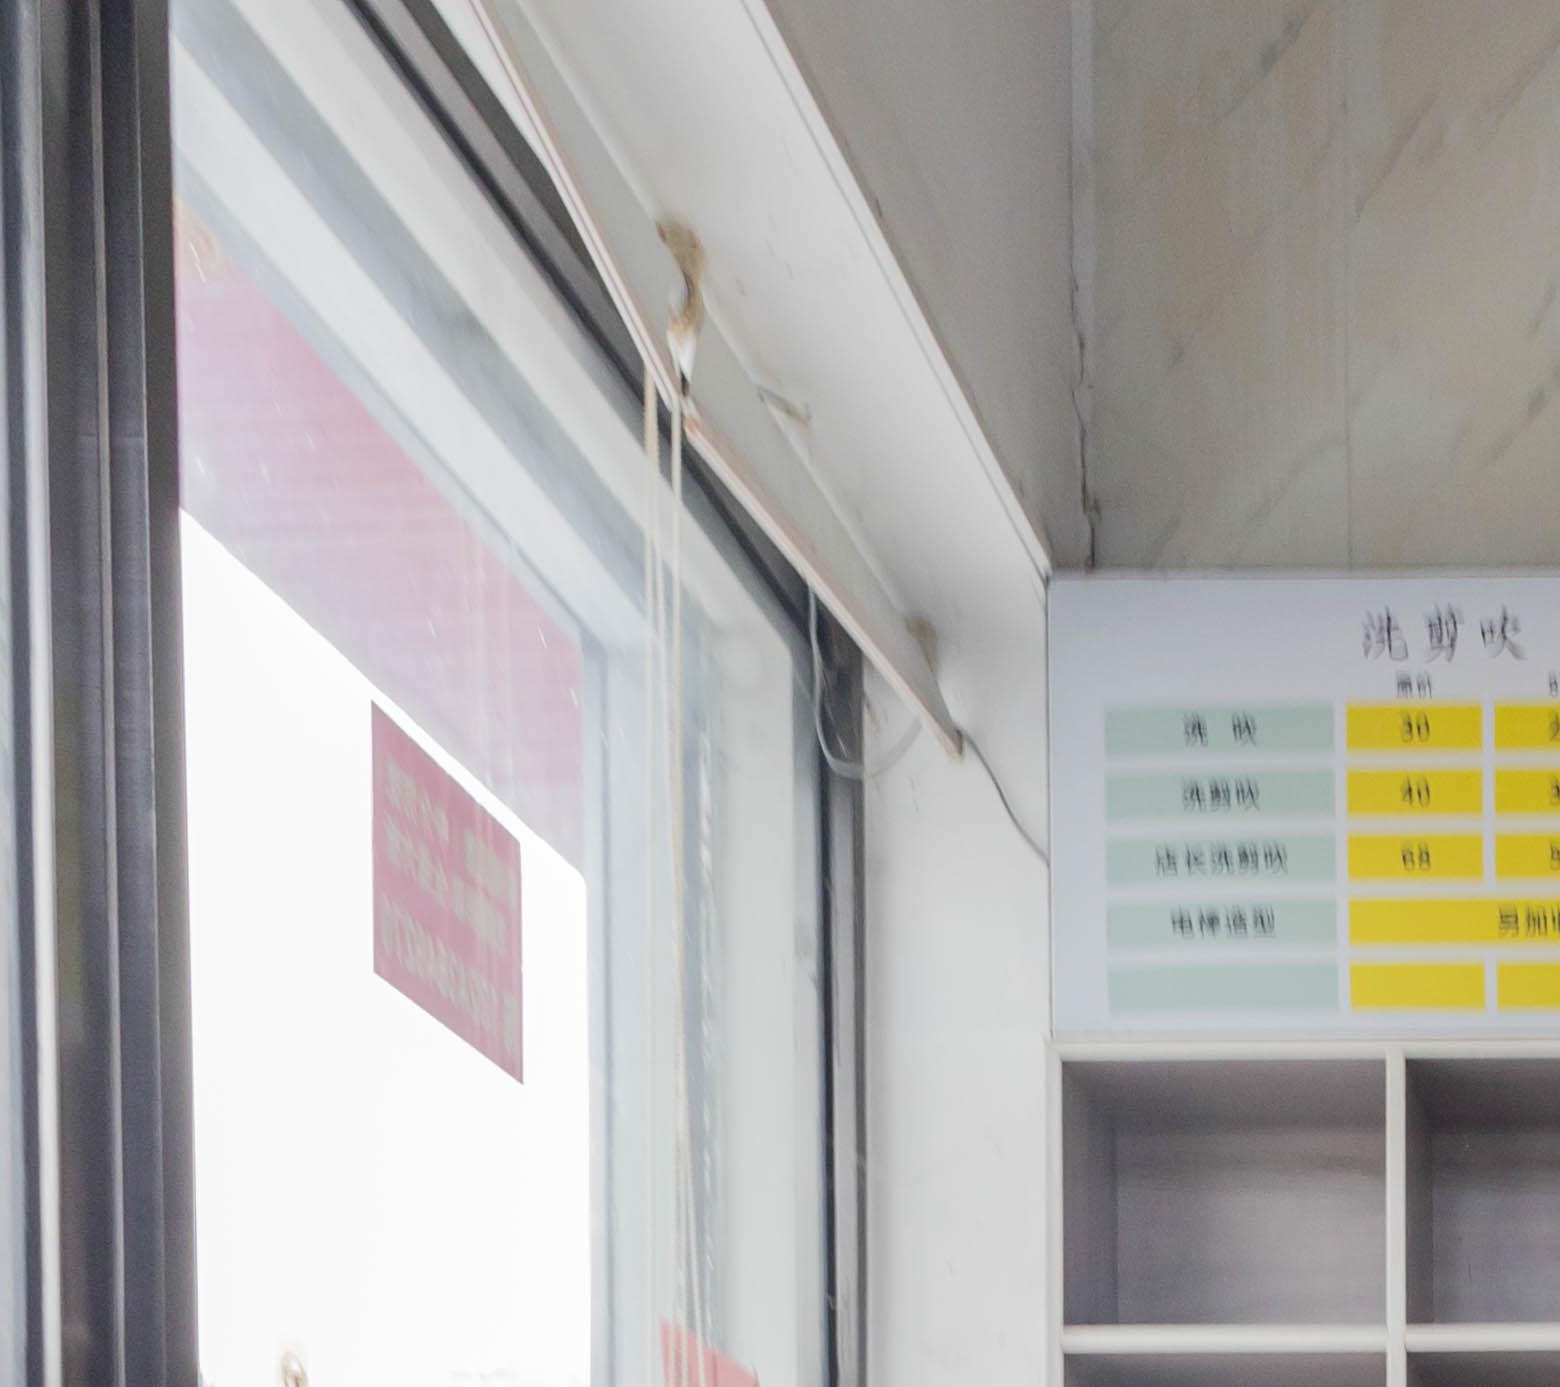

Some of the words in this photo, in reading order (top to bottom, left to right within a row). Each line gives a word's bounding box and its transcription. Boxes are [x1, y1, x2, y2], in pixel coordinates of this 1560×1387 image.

[1362, 602, 1526, 662] 洗剪吹
[1401, 712, 1431, 743] 30
[1401, 778, 1431, 809] 40
